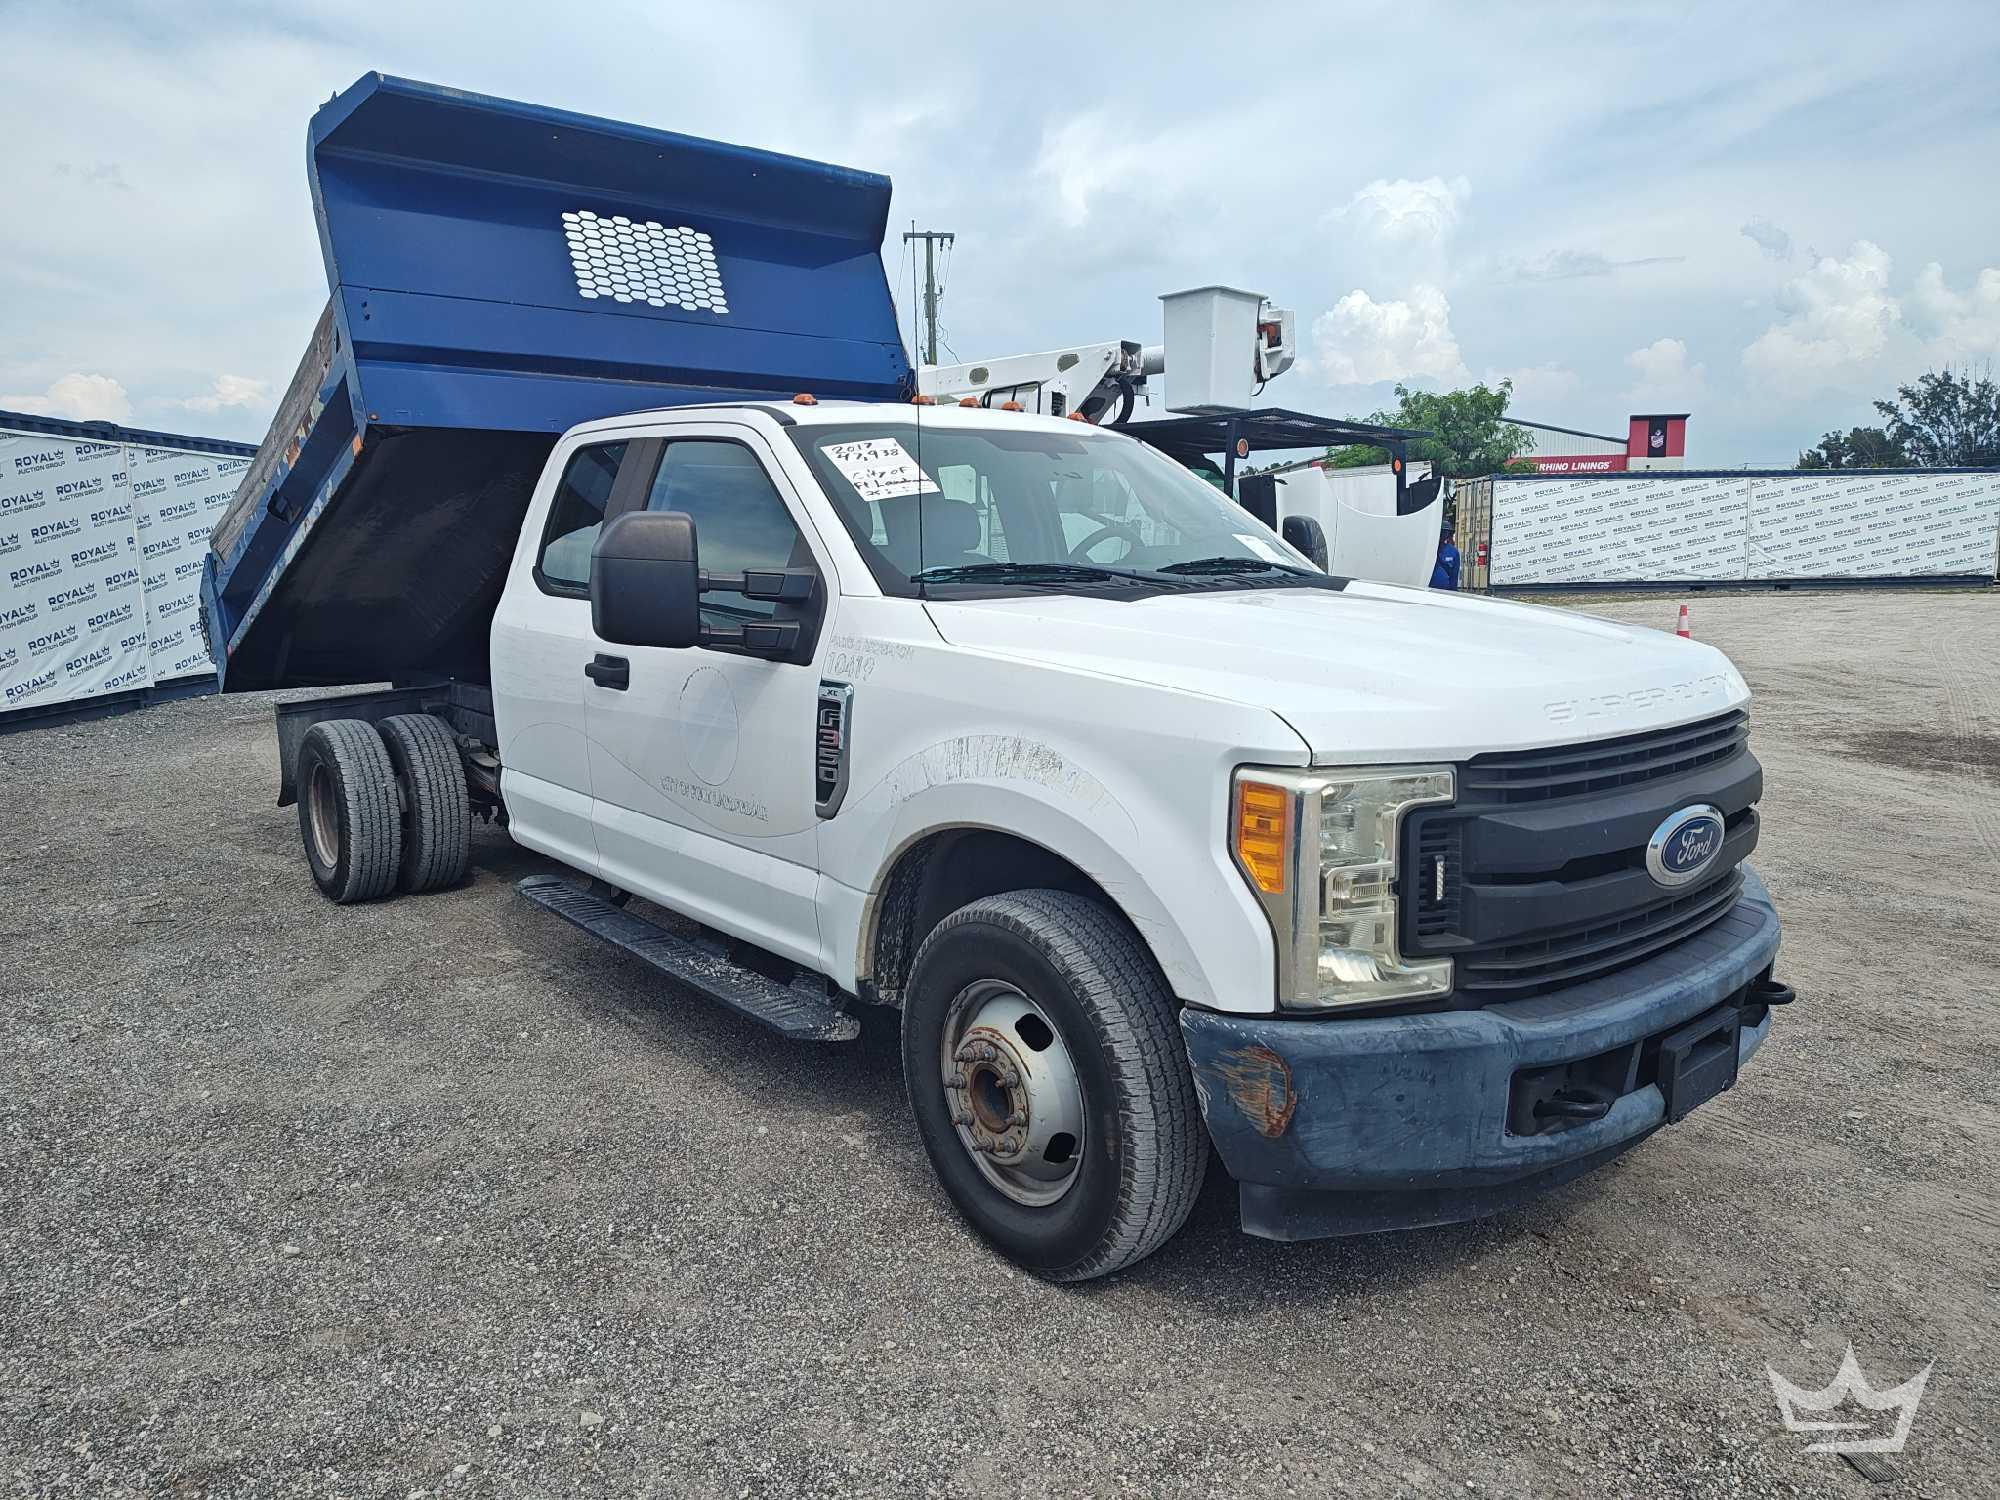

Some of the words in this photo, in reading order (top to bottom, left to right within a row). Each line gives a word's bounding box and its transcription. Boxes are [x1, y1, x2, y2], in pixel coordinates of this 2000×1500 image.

[15, 452, 54, 468] ROYAL
[217, 460, 241, 472] ROYAL
[1538, 462, 1568, 471] RHINO
[1571, 461, 1610, 471] LININGS
[174, 470, 202, 482] ROYAL
[56, 480, 93, 495] ROYAL
[134, 480, 157, 492] OYAL
[0, 493, 33, 508] OYAL
[204, 491, 230, 505] ROYAL
[0, 506, 22, 517] UCTION
[91, 507, 126, 522] ROYAL
[160, 503, 188, 517] ROYAL
[31, 521, 70, 538] ROYAL
[71, 545, 108, 563] ROYAL
[143, 540, 172, 554] ROYAL
[10, 563, 50, 581] ROYAL
[175, 560, 203, 575] ROYAL
[143, 575, 158, 587] YAL
[48, 587, 86, 606] ROYAL
[159, 597, 188, 613] ROYAL
[88, 608, 122, 627] ROYAL
[28, 630, 67, 650] ROYAL
[151, 634, 175, 649] OYAL
[150, 645, 168, 656] UCTION
[66, 651, 102, 672] ROYAL
[175, 653, 203, 670] ROYAL
[105, 670, 137, 689] ROYAL
[5, 677, 46, 698] ROYAL
[1677, 827, 1713, 864] Ford
